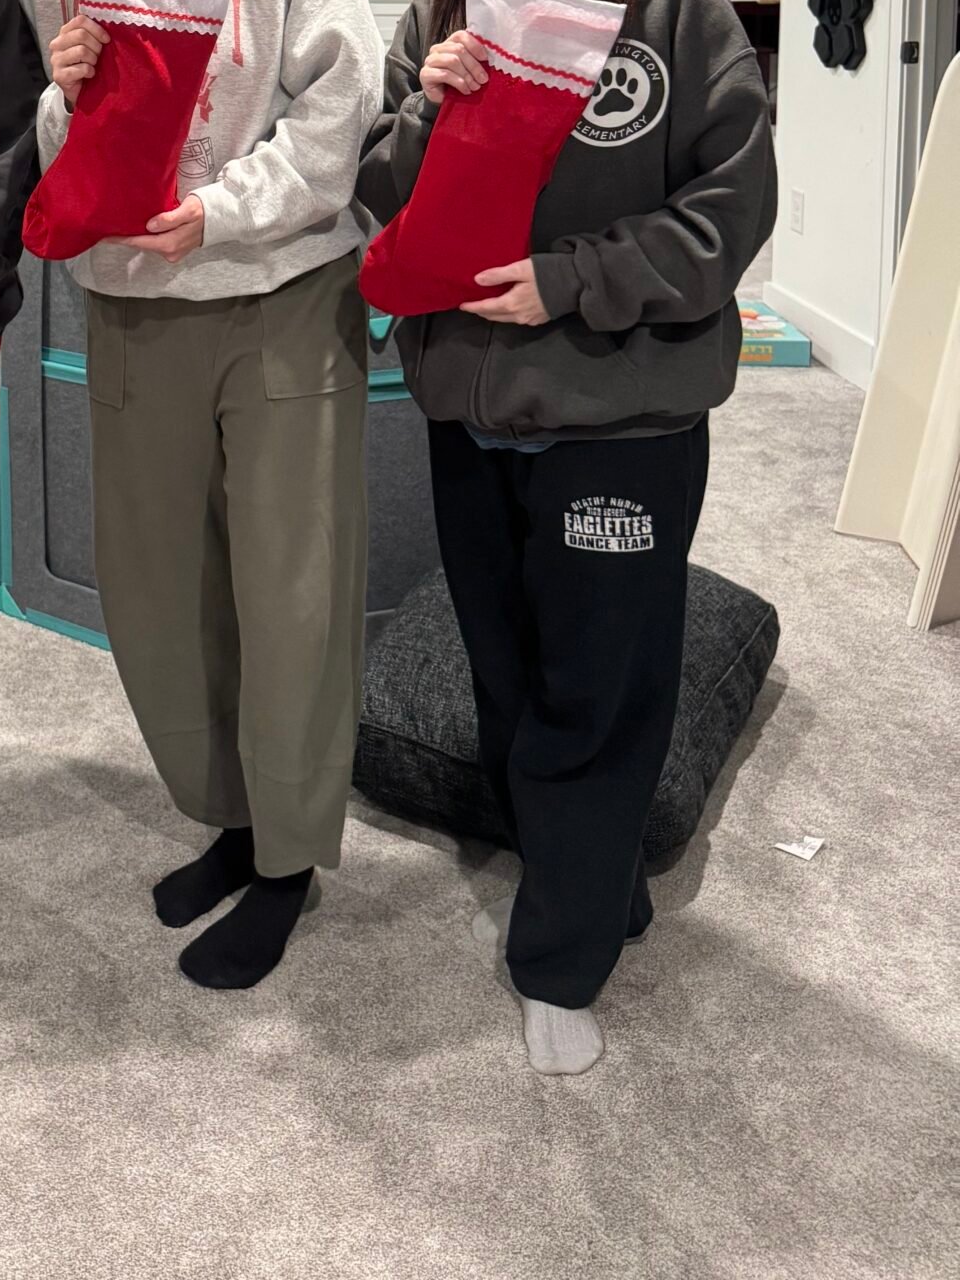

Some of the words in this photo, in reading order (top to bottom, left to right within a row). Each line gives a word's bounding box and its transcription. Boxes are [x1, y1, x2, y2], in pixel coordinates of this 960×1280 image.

[614, 45, 661, 81] INGTON
[576, 115, 648, 140] LEMENTARY
[563, 512, 653, 537] EAGLETTES
[569, 534, 612, 551] DANCE
[617, 536, 651, 551] TEAM
